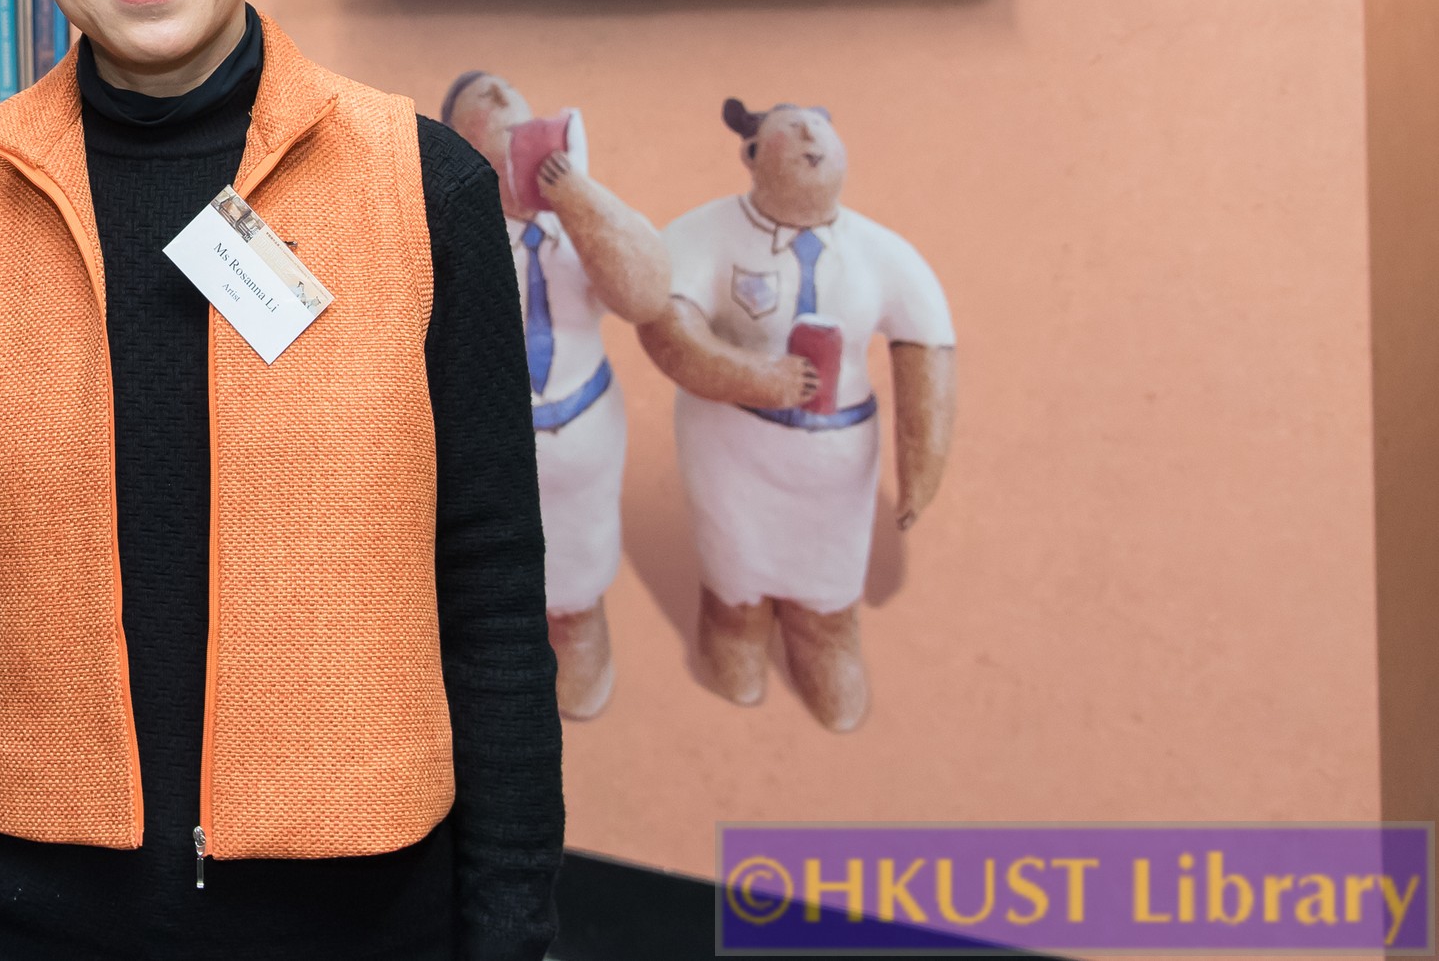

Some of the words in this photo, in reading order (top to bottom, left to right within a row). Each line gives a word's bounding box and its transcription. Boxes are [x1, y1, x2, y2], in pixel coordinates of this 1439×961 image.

[213, 242, 230, 262] Ms
[229, 258, 265, 301] Rosanna
[265, 297, 280, 314] Li
[221, 282, 241, 302] Artist
